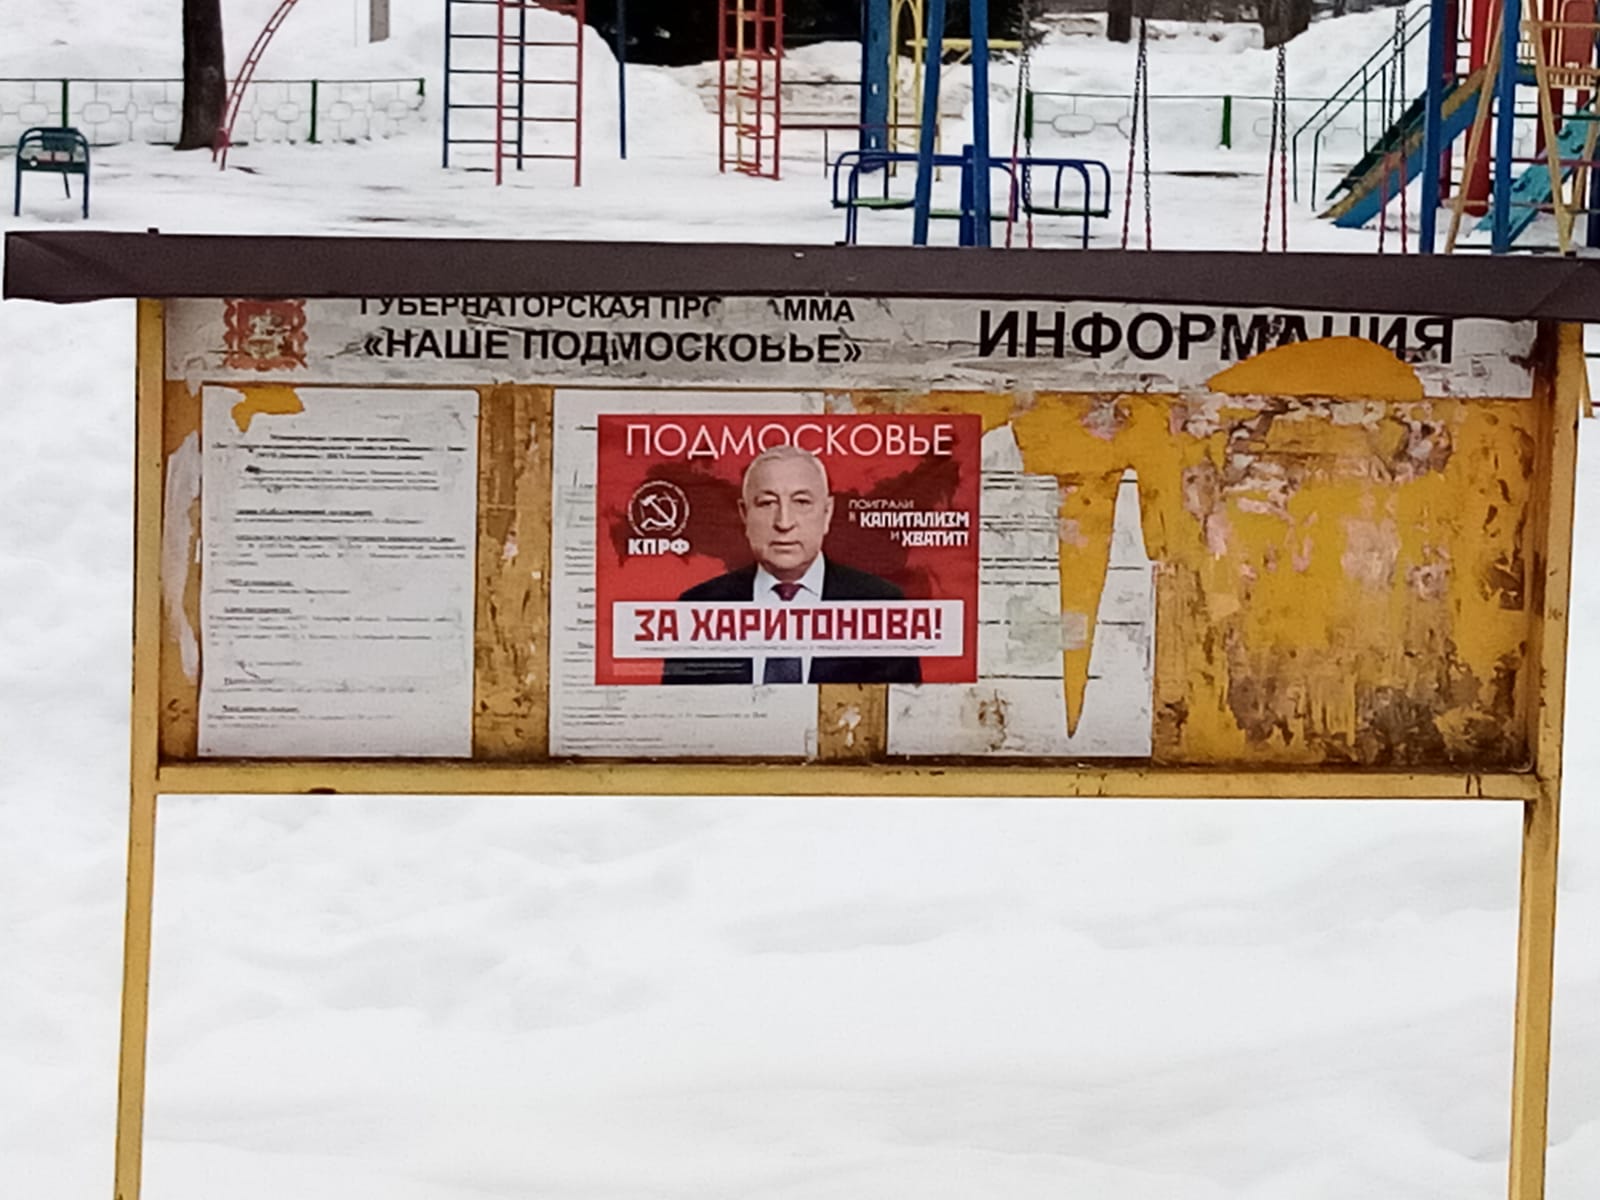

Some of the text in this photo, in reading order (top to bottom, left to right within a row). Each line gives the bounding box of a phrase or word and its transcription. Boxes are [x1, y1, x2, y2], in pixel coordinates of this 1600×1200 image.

[360, 296, 650, 319] ГУБЕРНАТОРСКАЯ
[363, 328, 862, 366] «НАШЕ ПОДМОСКОВЬЕ»
[626, 423, 953, 459] ПОДМОСКОВЬЕ
[860, 511, 970, 528] КАПИТАЛИЗМ
[628, 538, 690, 555] КПРФ
[634, 608, 680, 642] ЗА
[690, 607, 943, 642] ХАРИТОНОВА!
